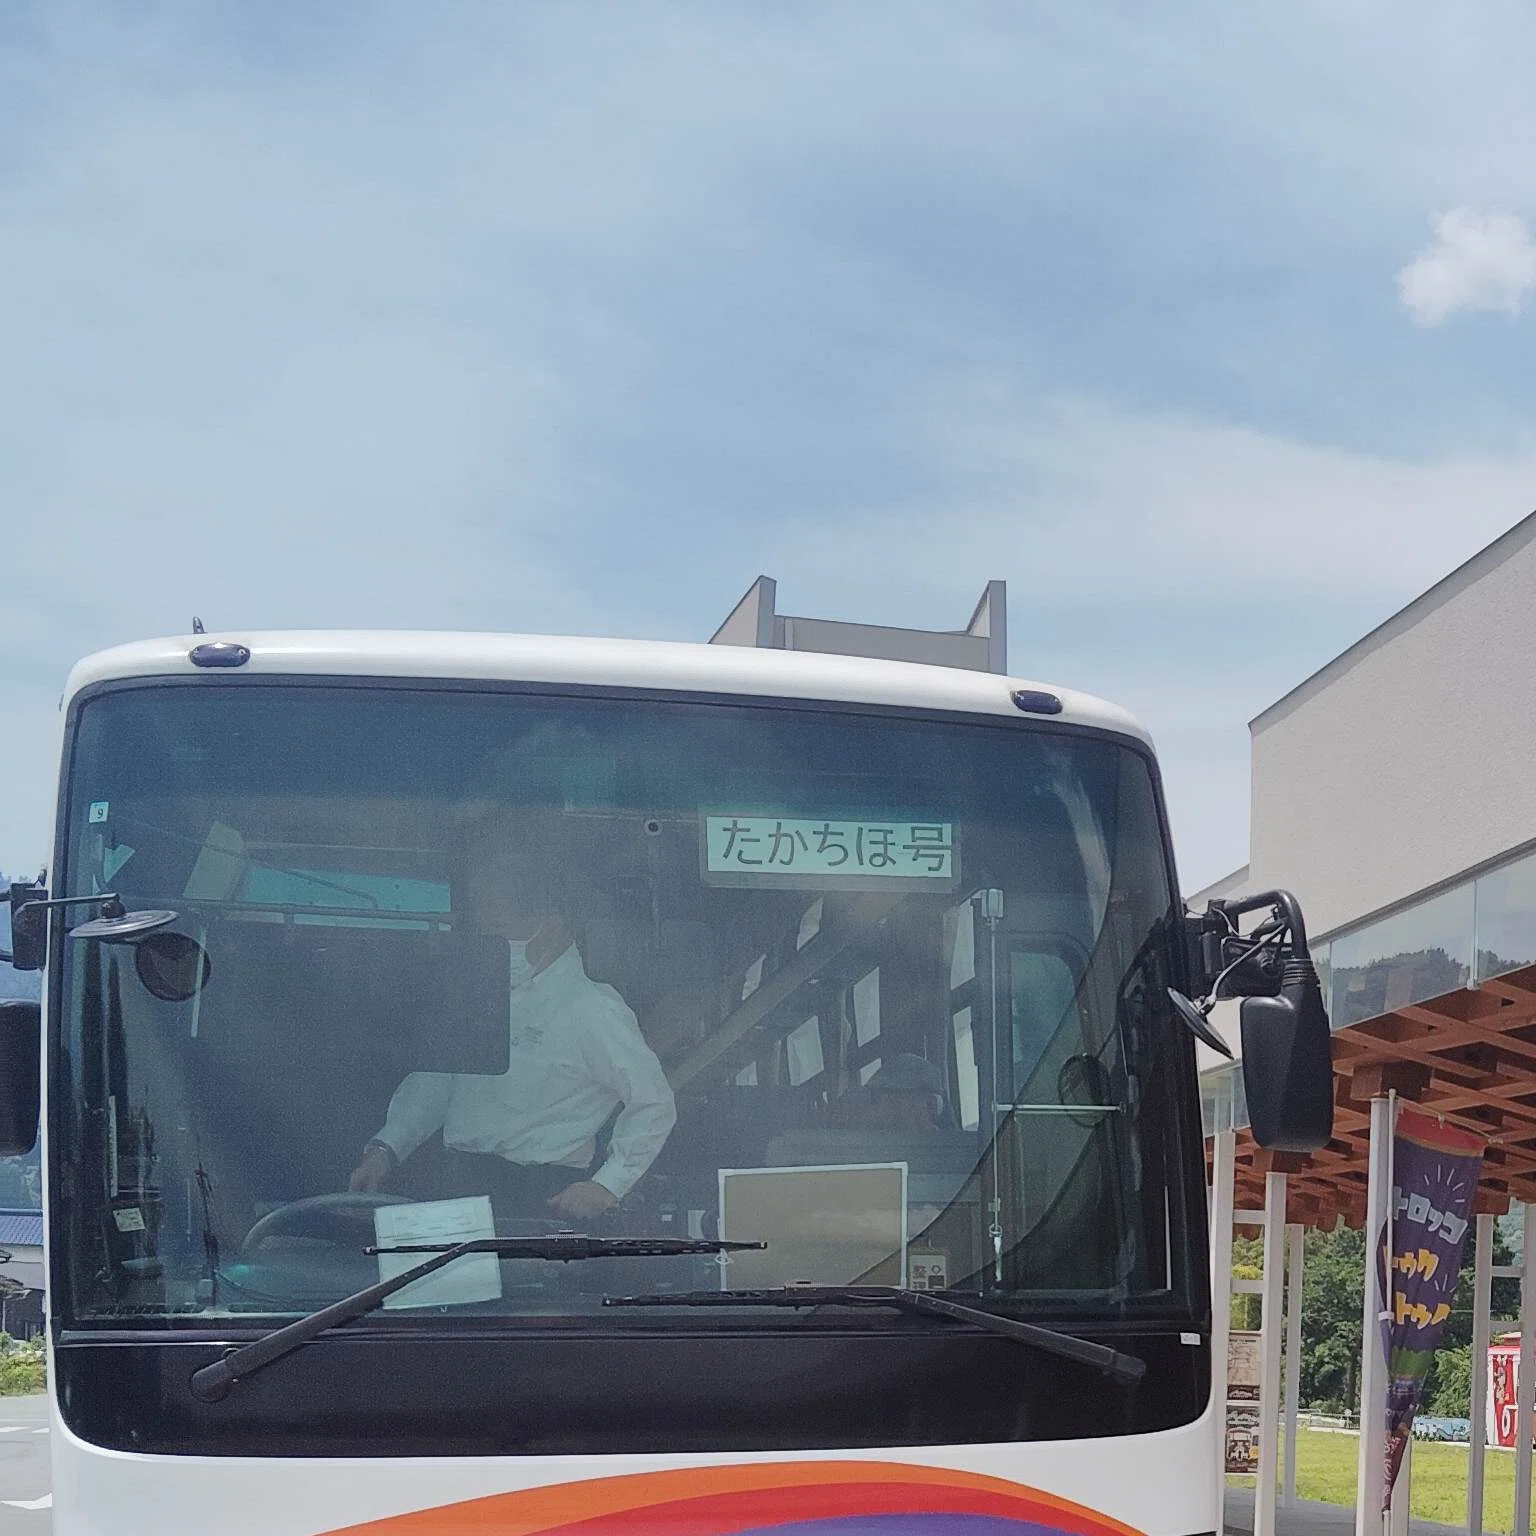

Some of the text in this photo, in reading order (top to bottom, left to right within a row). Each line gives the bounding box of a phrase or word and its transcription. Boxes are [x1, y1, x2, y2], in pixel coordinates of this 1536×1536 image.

[722, 819, 952, 872] たかちほ号
[1393, 1186, 1469, 1245] トロッコ
